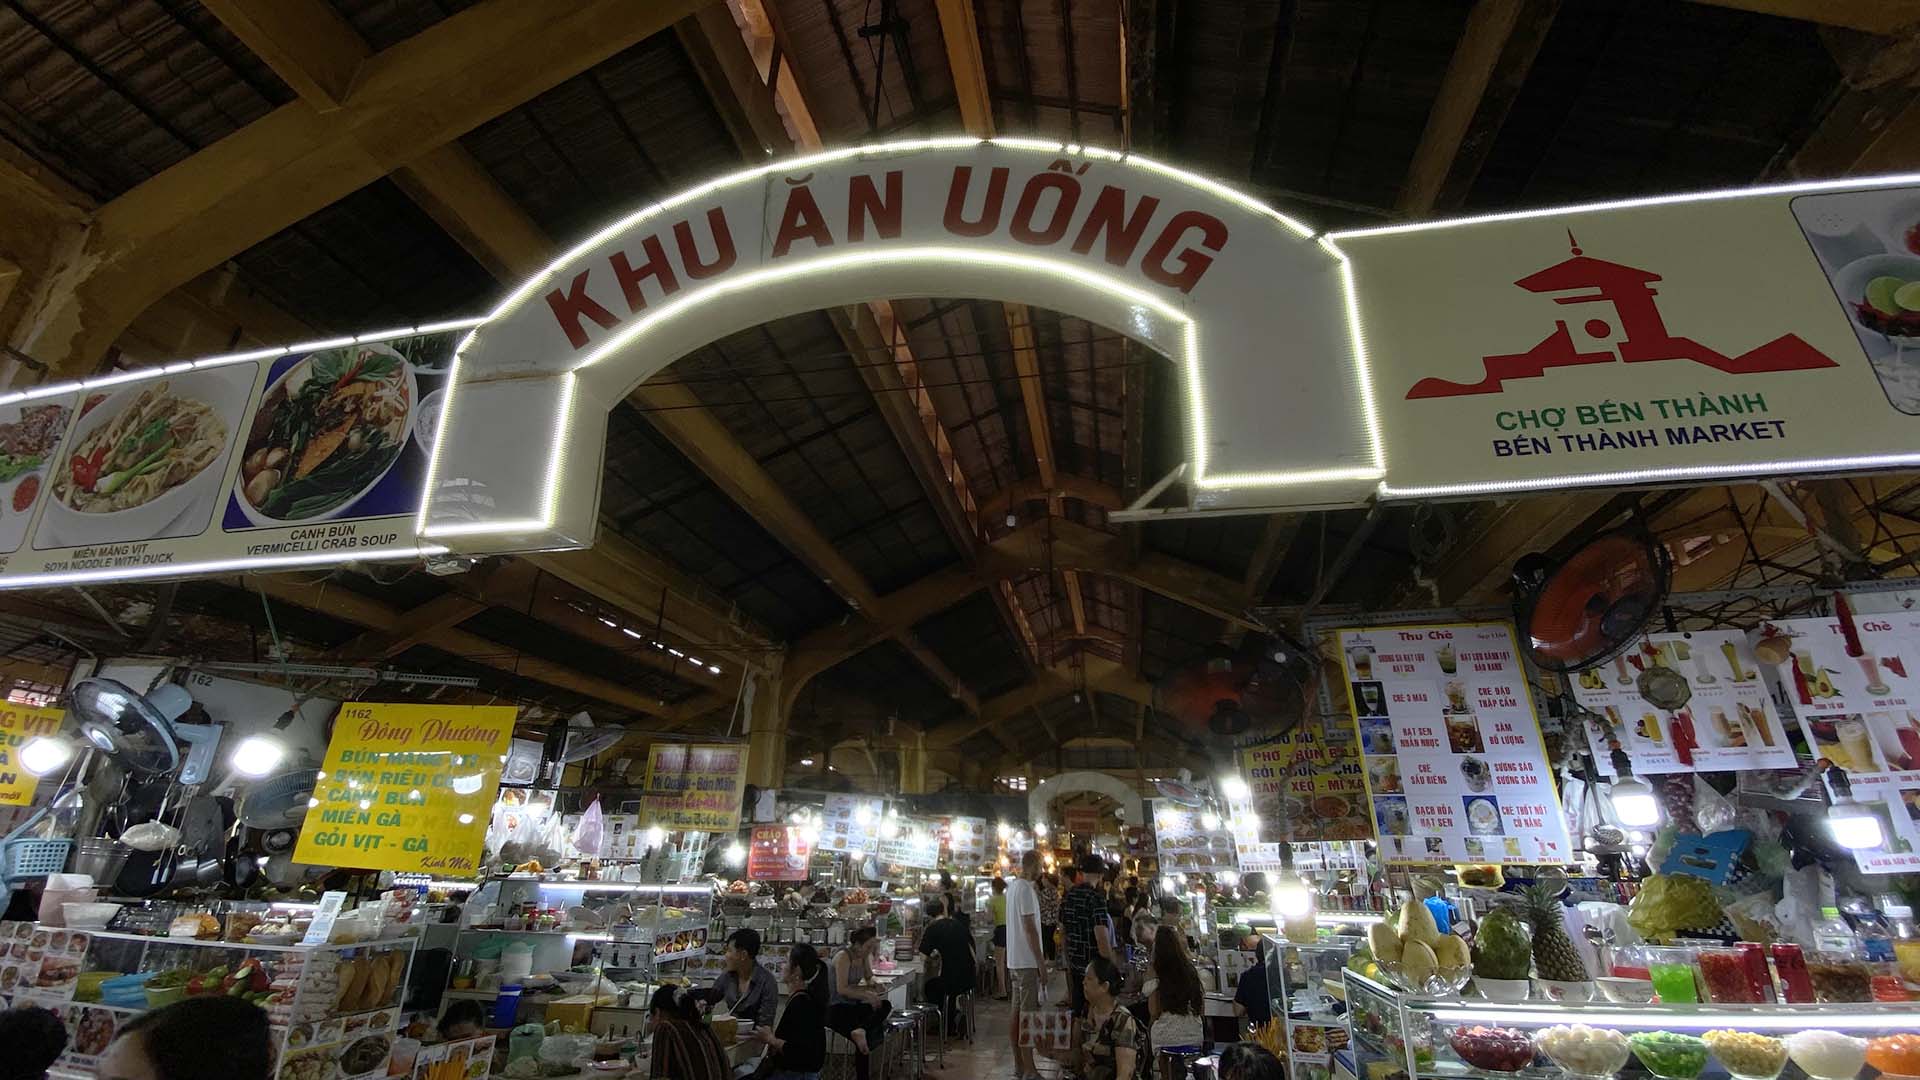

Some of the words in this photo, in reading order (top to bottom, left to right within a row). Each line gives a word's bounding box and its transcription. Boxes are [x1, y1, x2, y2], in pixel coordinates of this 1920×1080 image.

[545, 206, 737, 350] KHU
[771, 170, 903, 258] ĂN
[942, 158, 1229, 294] UỐNG
[1496, 407, 1566, 432] CHỢ
[1650, 392, 1768, 419] THÀNH
[1558, 428, 1658, 453] THÀNH
[1665, 420, 1785, 445] MARKET
[290, 527, 326, 541] CANH
[328, 523, 357, 538] BÚN
[246, 540, 318, 556] VERMICELLI
[321, 536, 358, 550] CRAB
[360, 533, 397, 546] SOUP
[43, 561, 68, 572] SOYA
[70, 557, 111, 571] NOODLE
[114, 554, 140, 567] WITH
[143, 552, 174, 565] DUCK
[1863, 620, 1892, 632] Chè
[345, 708, 373, 720] 1162
[358, 719, 414, 745] Đông
[419, 718, 501, 747] Phương
[376, 809, 401, 827] GÀ
[313, 826, 347, 847] GỎI
[354, 834, 384, 852] VỊT
[402, 833, 429, 853] GÀ
